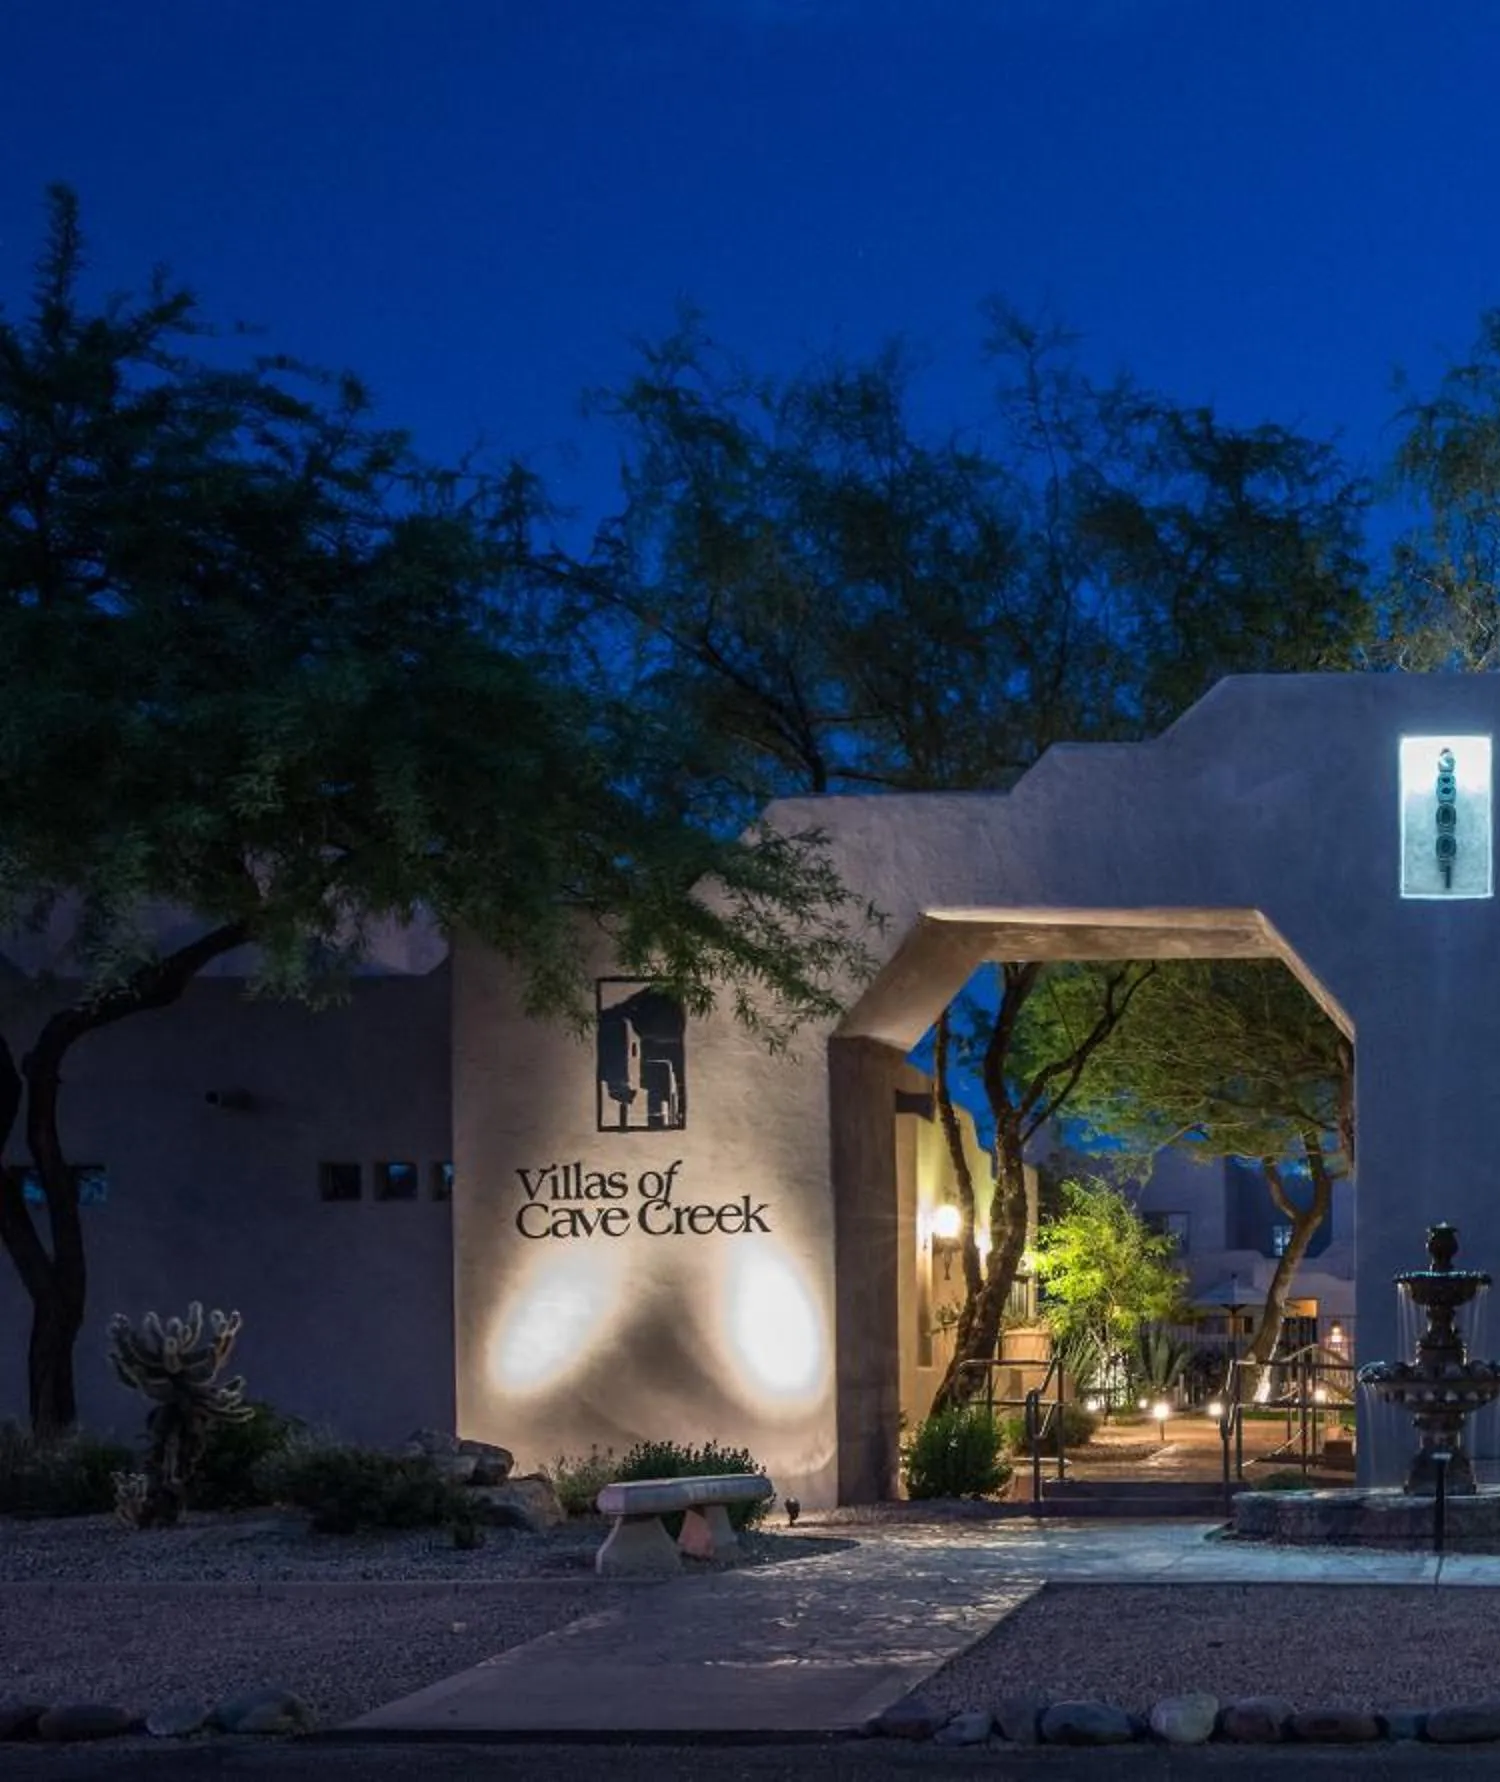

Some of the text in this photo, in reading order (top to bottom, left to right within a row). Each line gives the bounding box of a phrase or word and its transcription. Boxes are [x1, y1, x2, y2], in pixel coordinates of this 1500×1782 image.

[515, 1159, 682, 1210] Villas of
[515, 1194, 771, 1239] Cave Creek
